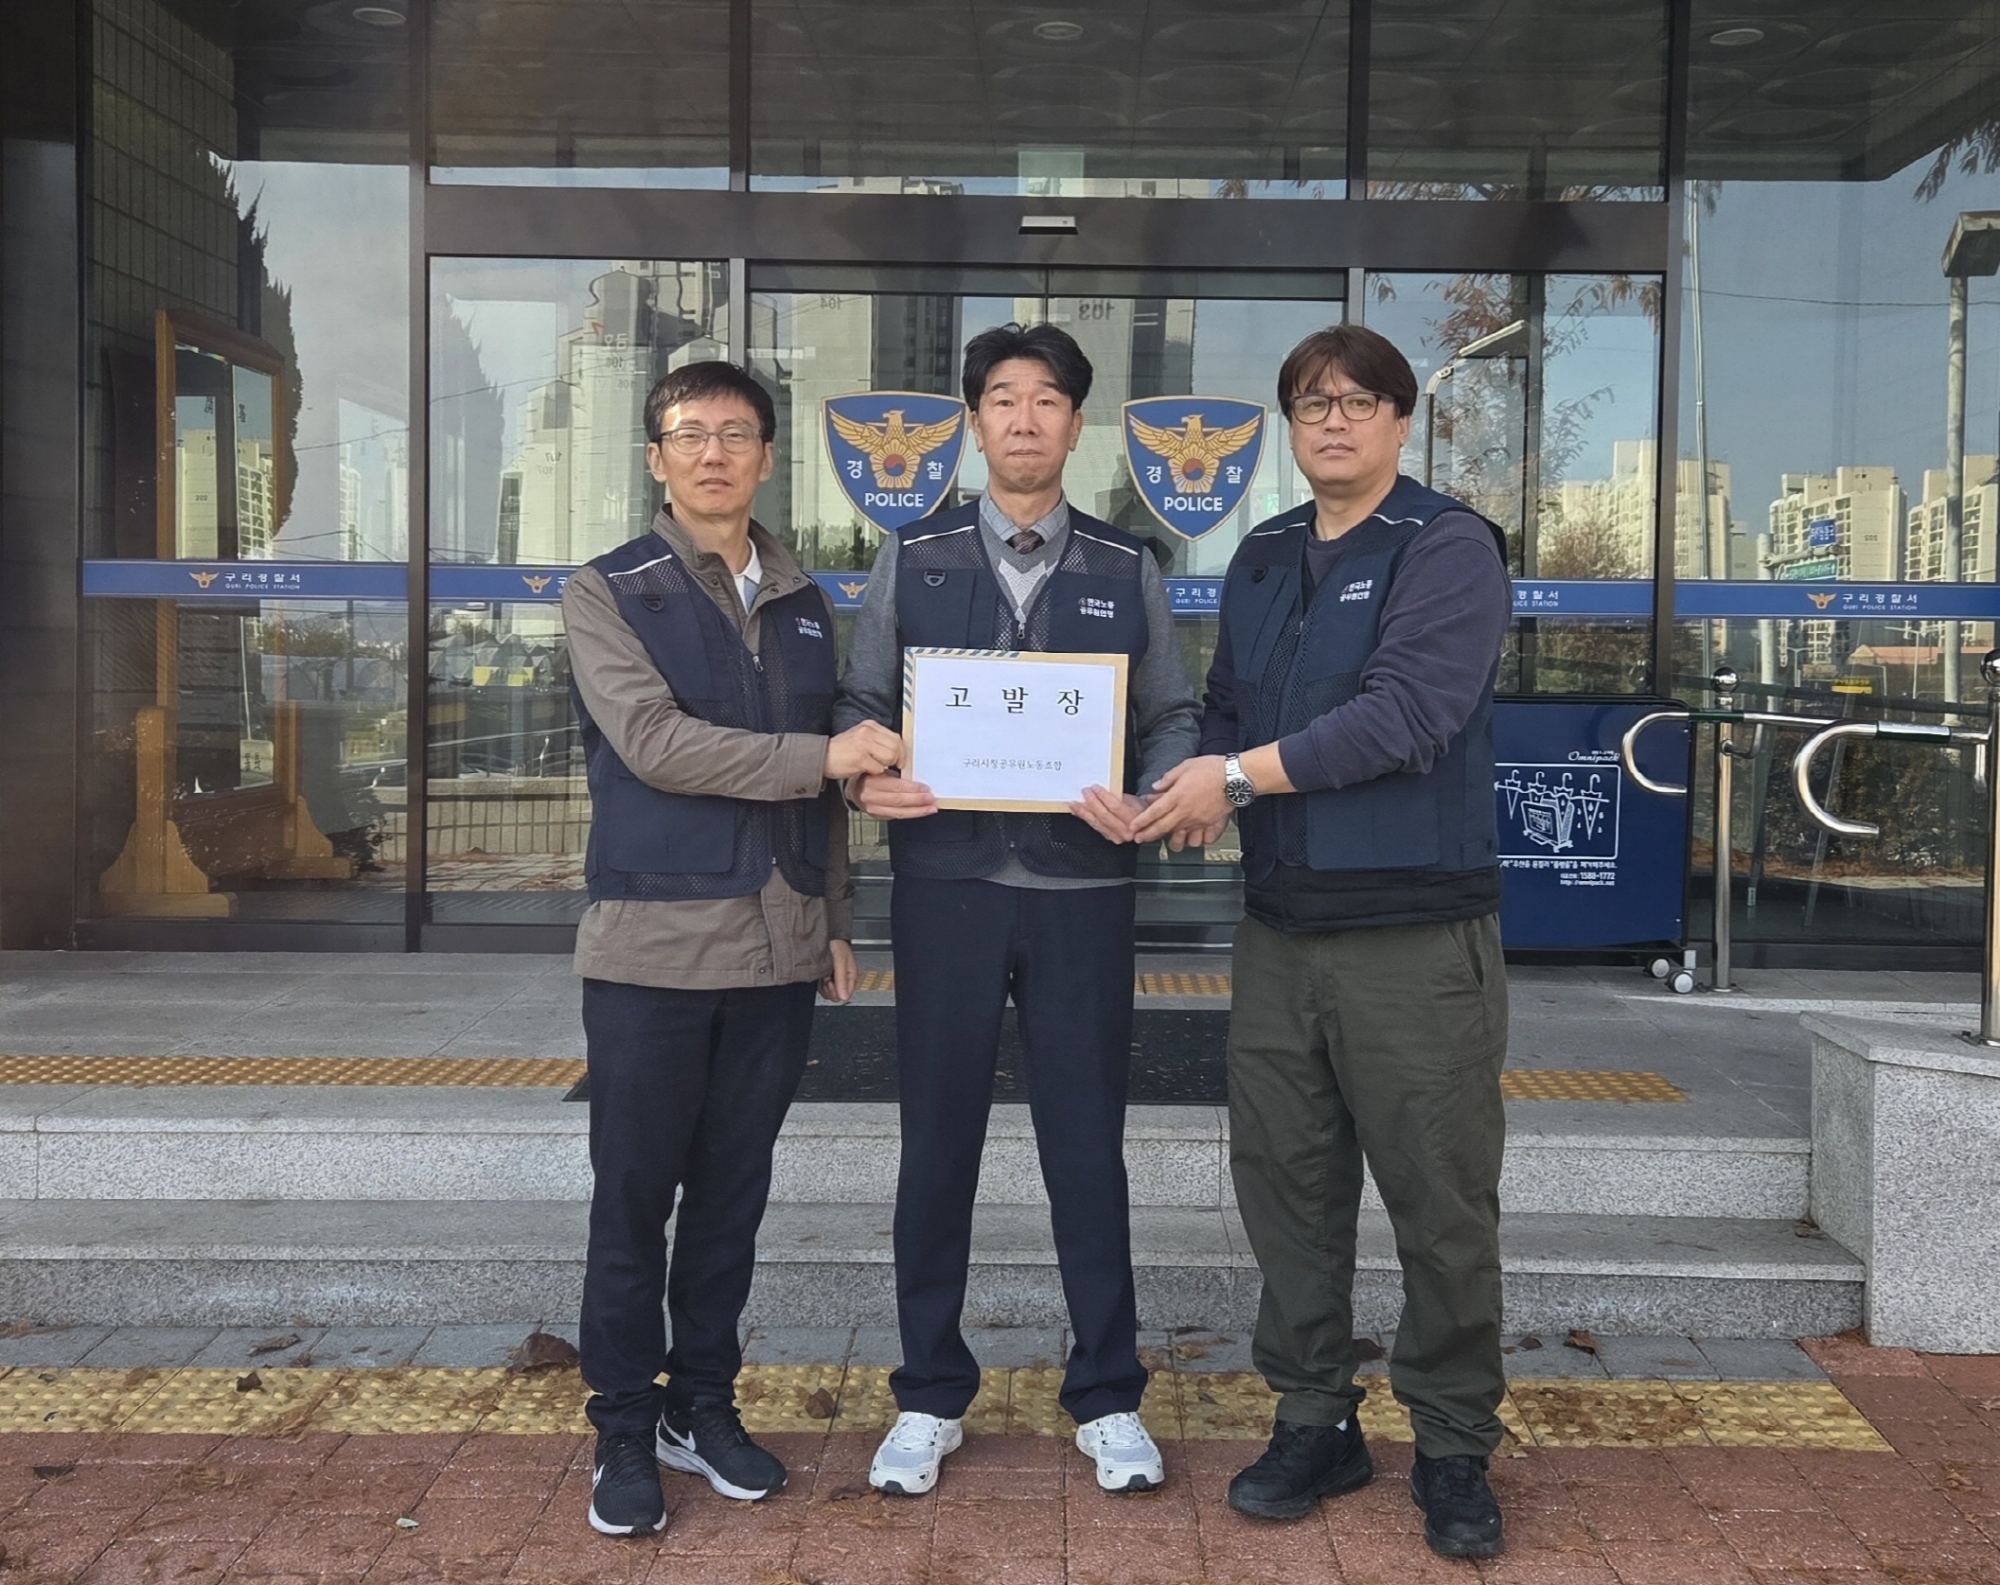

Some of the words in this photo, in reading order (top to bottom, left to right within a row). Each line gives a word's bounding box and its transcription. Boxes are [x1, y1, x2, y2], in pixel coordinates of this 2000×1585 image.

[846, 460, 863, 479] 경
[927, 460, 944, 480] 찰
[1146, 466, 1162, 484] 경
[1226, 465, 1243, 484] 찰
[864, 493, 924, 507] POLICE
[1163, 497, 1223, 511] POLICE
[1568, 751, 1620, 763] Omnipack
[963, 758, 1062, 771] 구리시청공무원노동조합
[1580, 872, 1616, 880] 1588-1772
